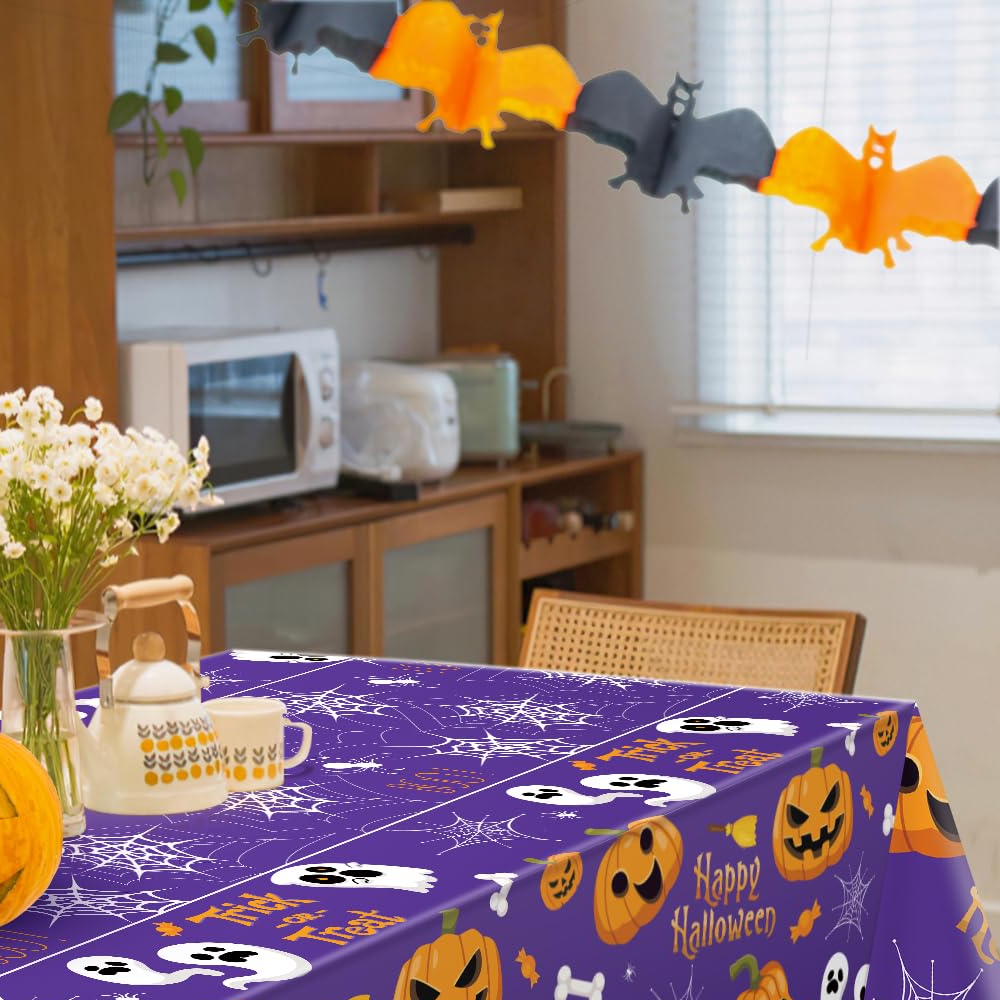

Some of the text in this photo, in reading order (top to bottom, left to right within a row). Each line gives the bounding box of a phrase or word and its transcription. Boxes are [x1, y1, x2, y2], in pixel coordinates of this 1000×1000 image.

[595, 738, 706, 762] Trick
[684, 749, 784, 775] Treat
[693, 852, 761, 908] Happy
[185, 893, 320, 927] Trick
[282, 910, 406, 947] Treat
[671, 904, 777, 961] Halloween
